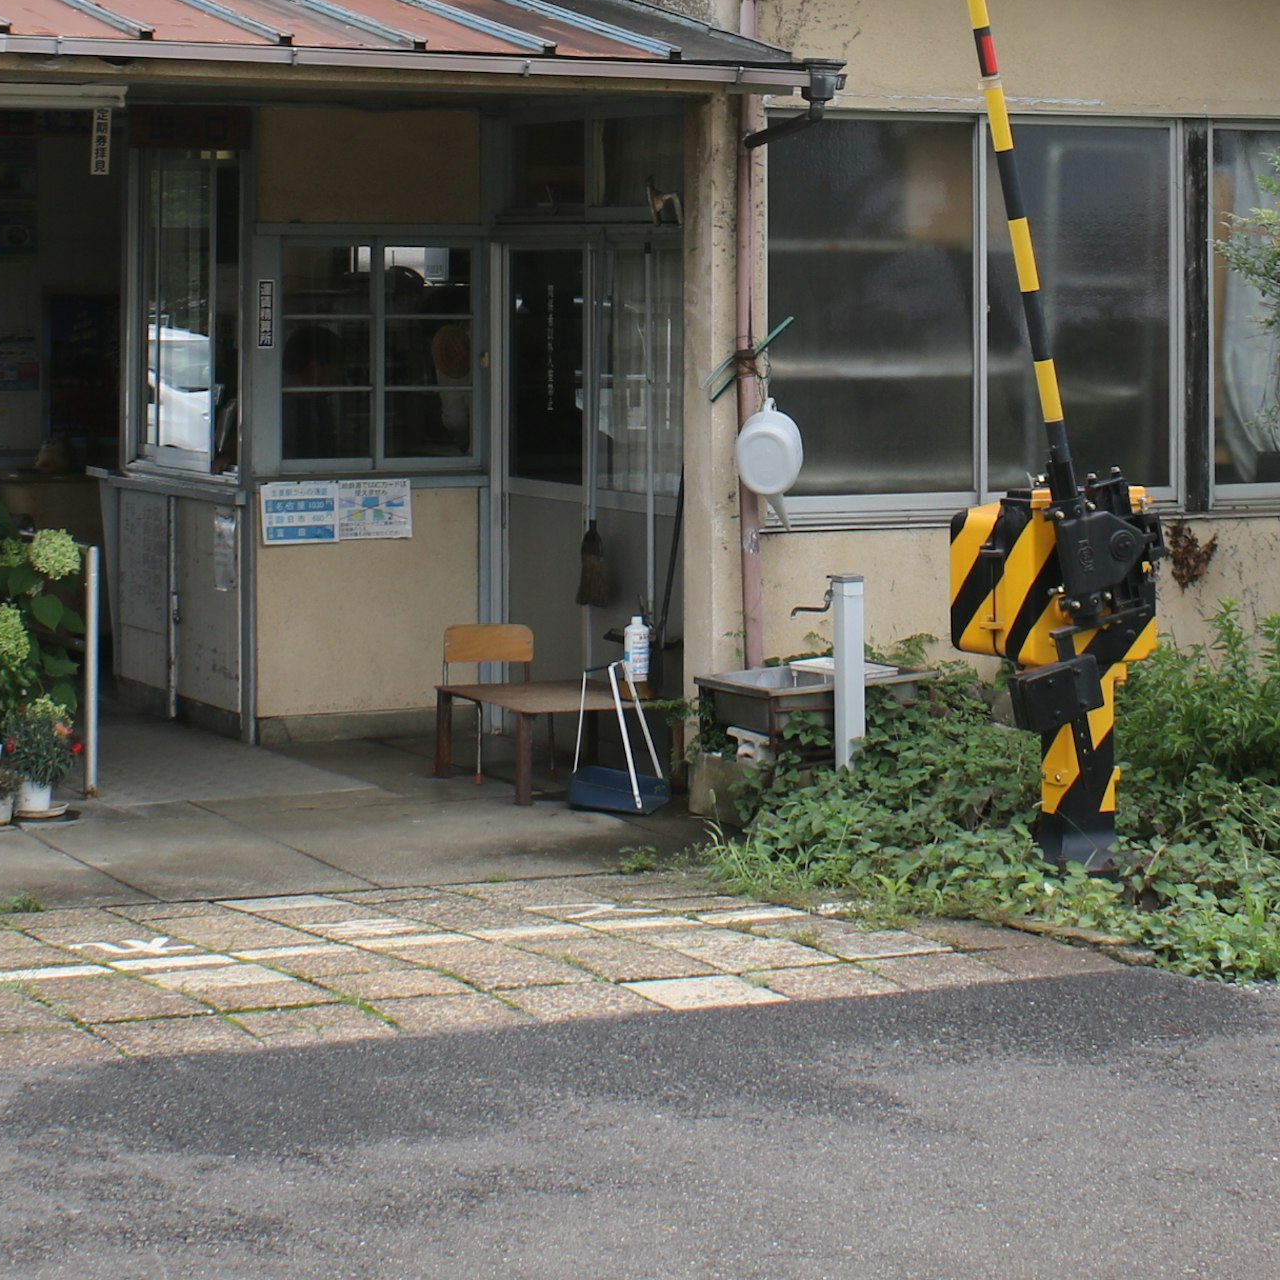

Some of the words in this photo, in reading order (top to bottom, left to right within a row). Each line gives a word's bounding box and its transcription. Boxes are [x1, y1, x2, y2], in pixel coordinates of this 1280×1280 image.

[94, 108, 109, 173] 定期券拝見
